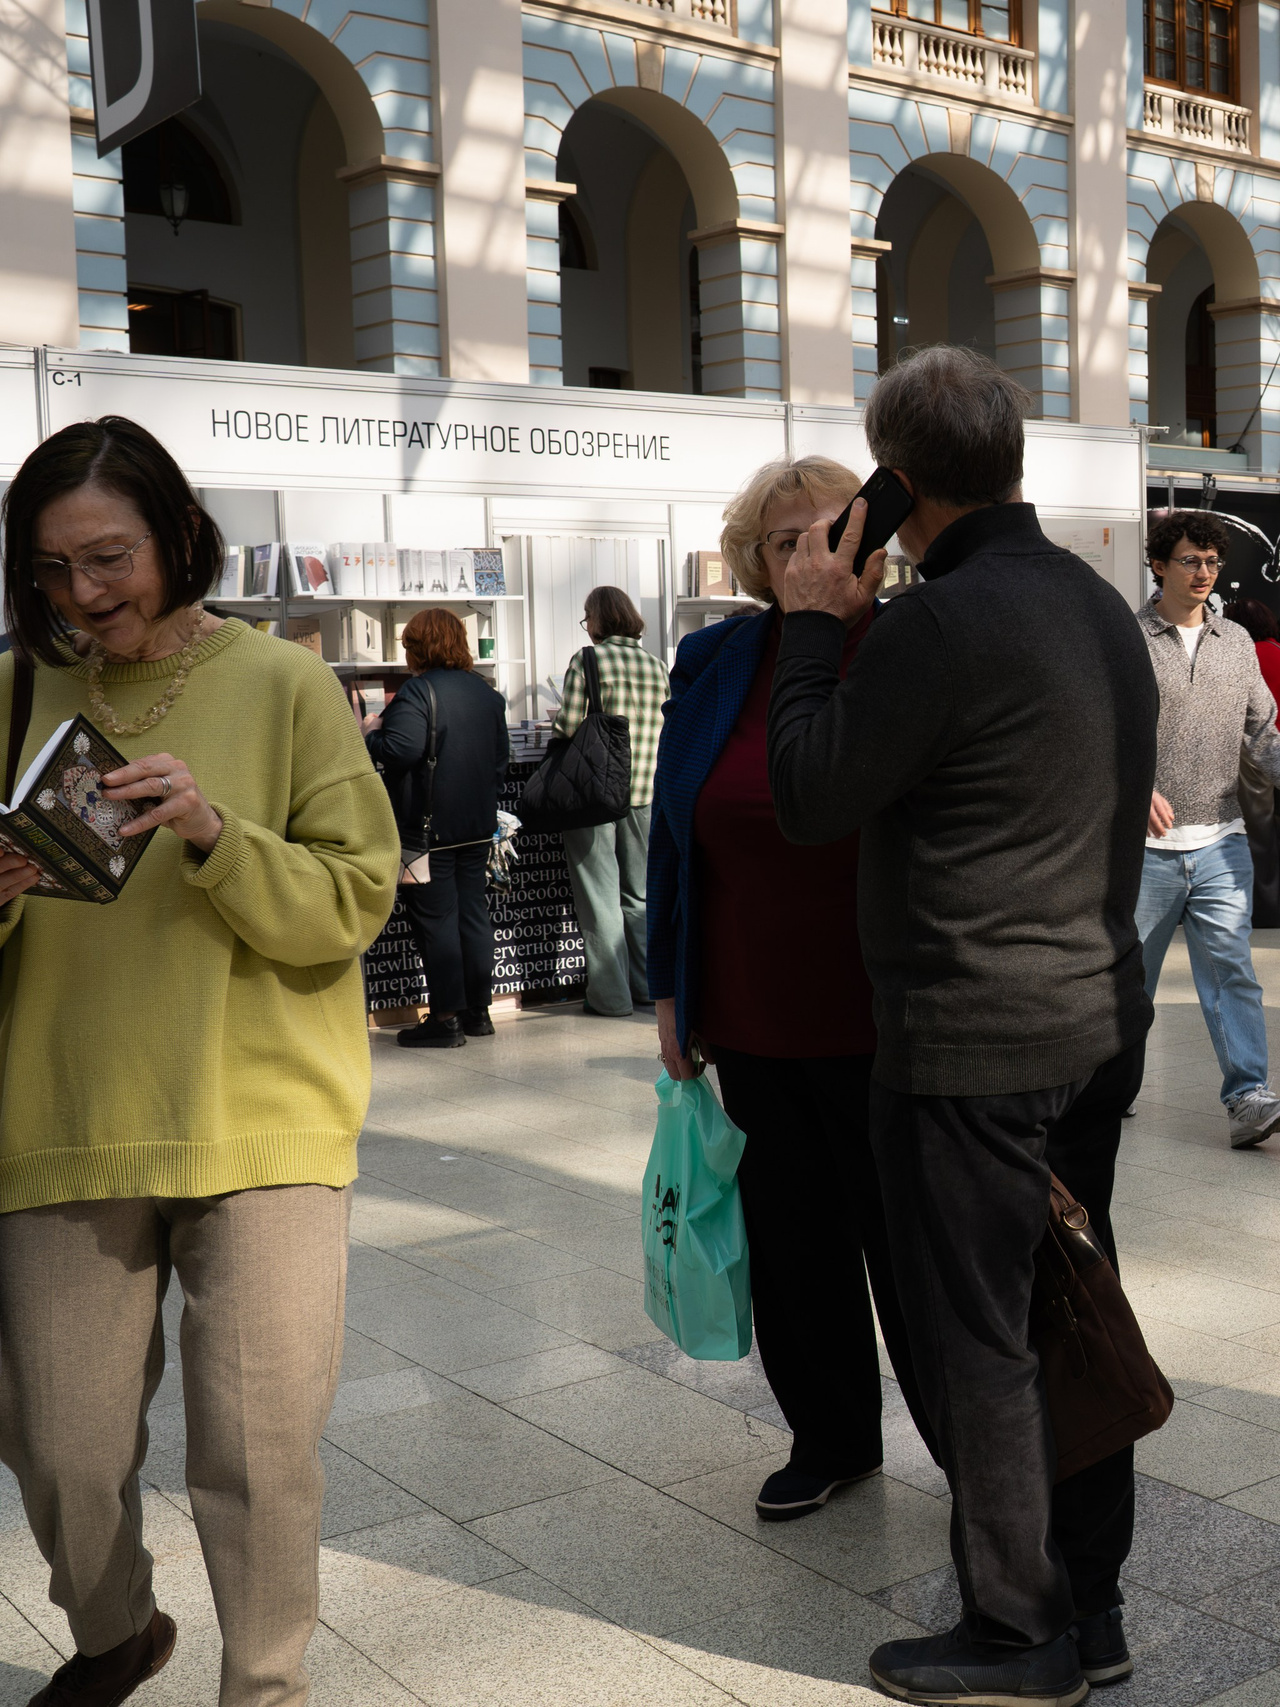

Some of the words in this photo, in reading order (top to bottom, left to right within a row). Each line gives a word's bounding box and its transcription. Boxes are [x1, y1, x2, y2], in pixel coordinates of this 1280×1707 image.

[52, 371, 82, 387] C-1
[211, 408, 309, 443] НОВОЕ
[320, 416, 521, 453] ЛИТЕРАТУРНОЕ
[530, 428, 670, 460] ОБОЗРЕНИЕ
